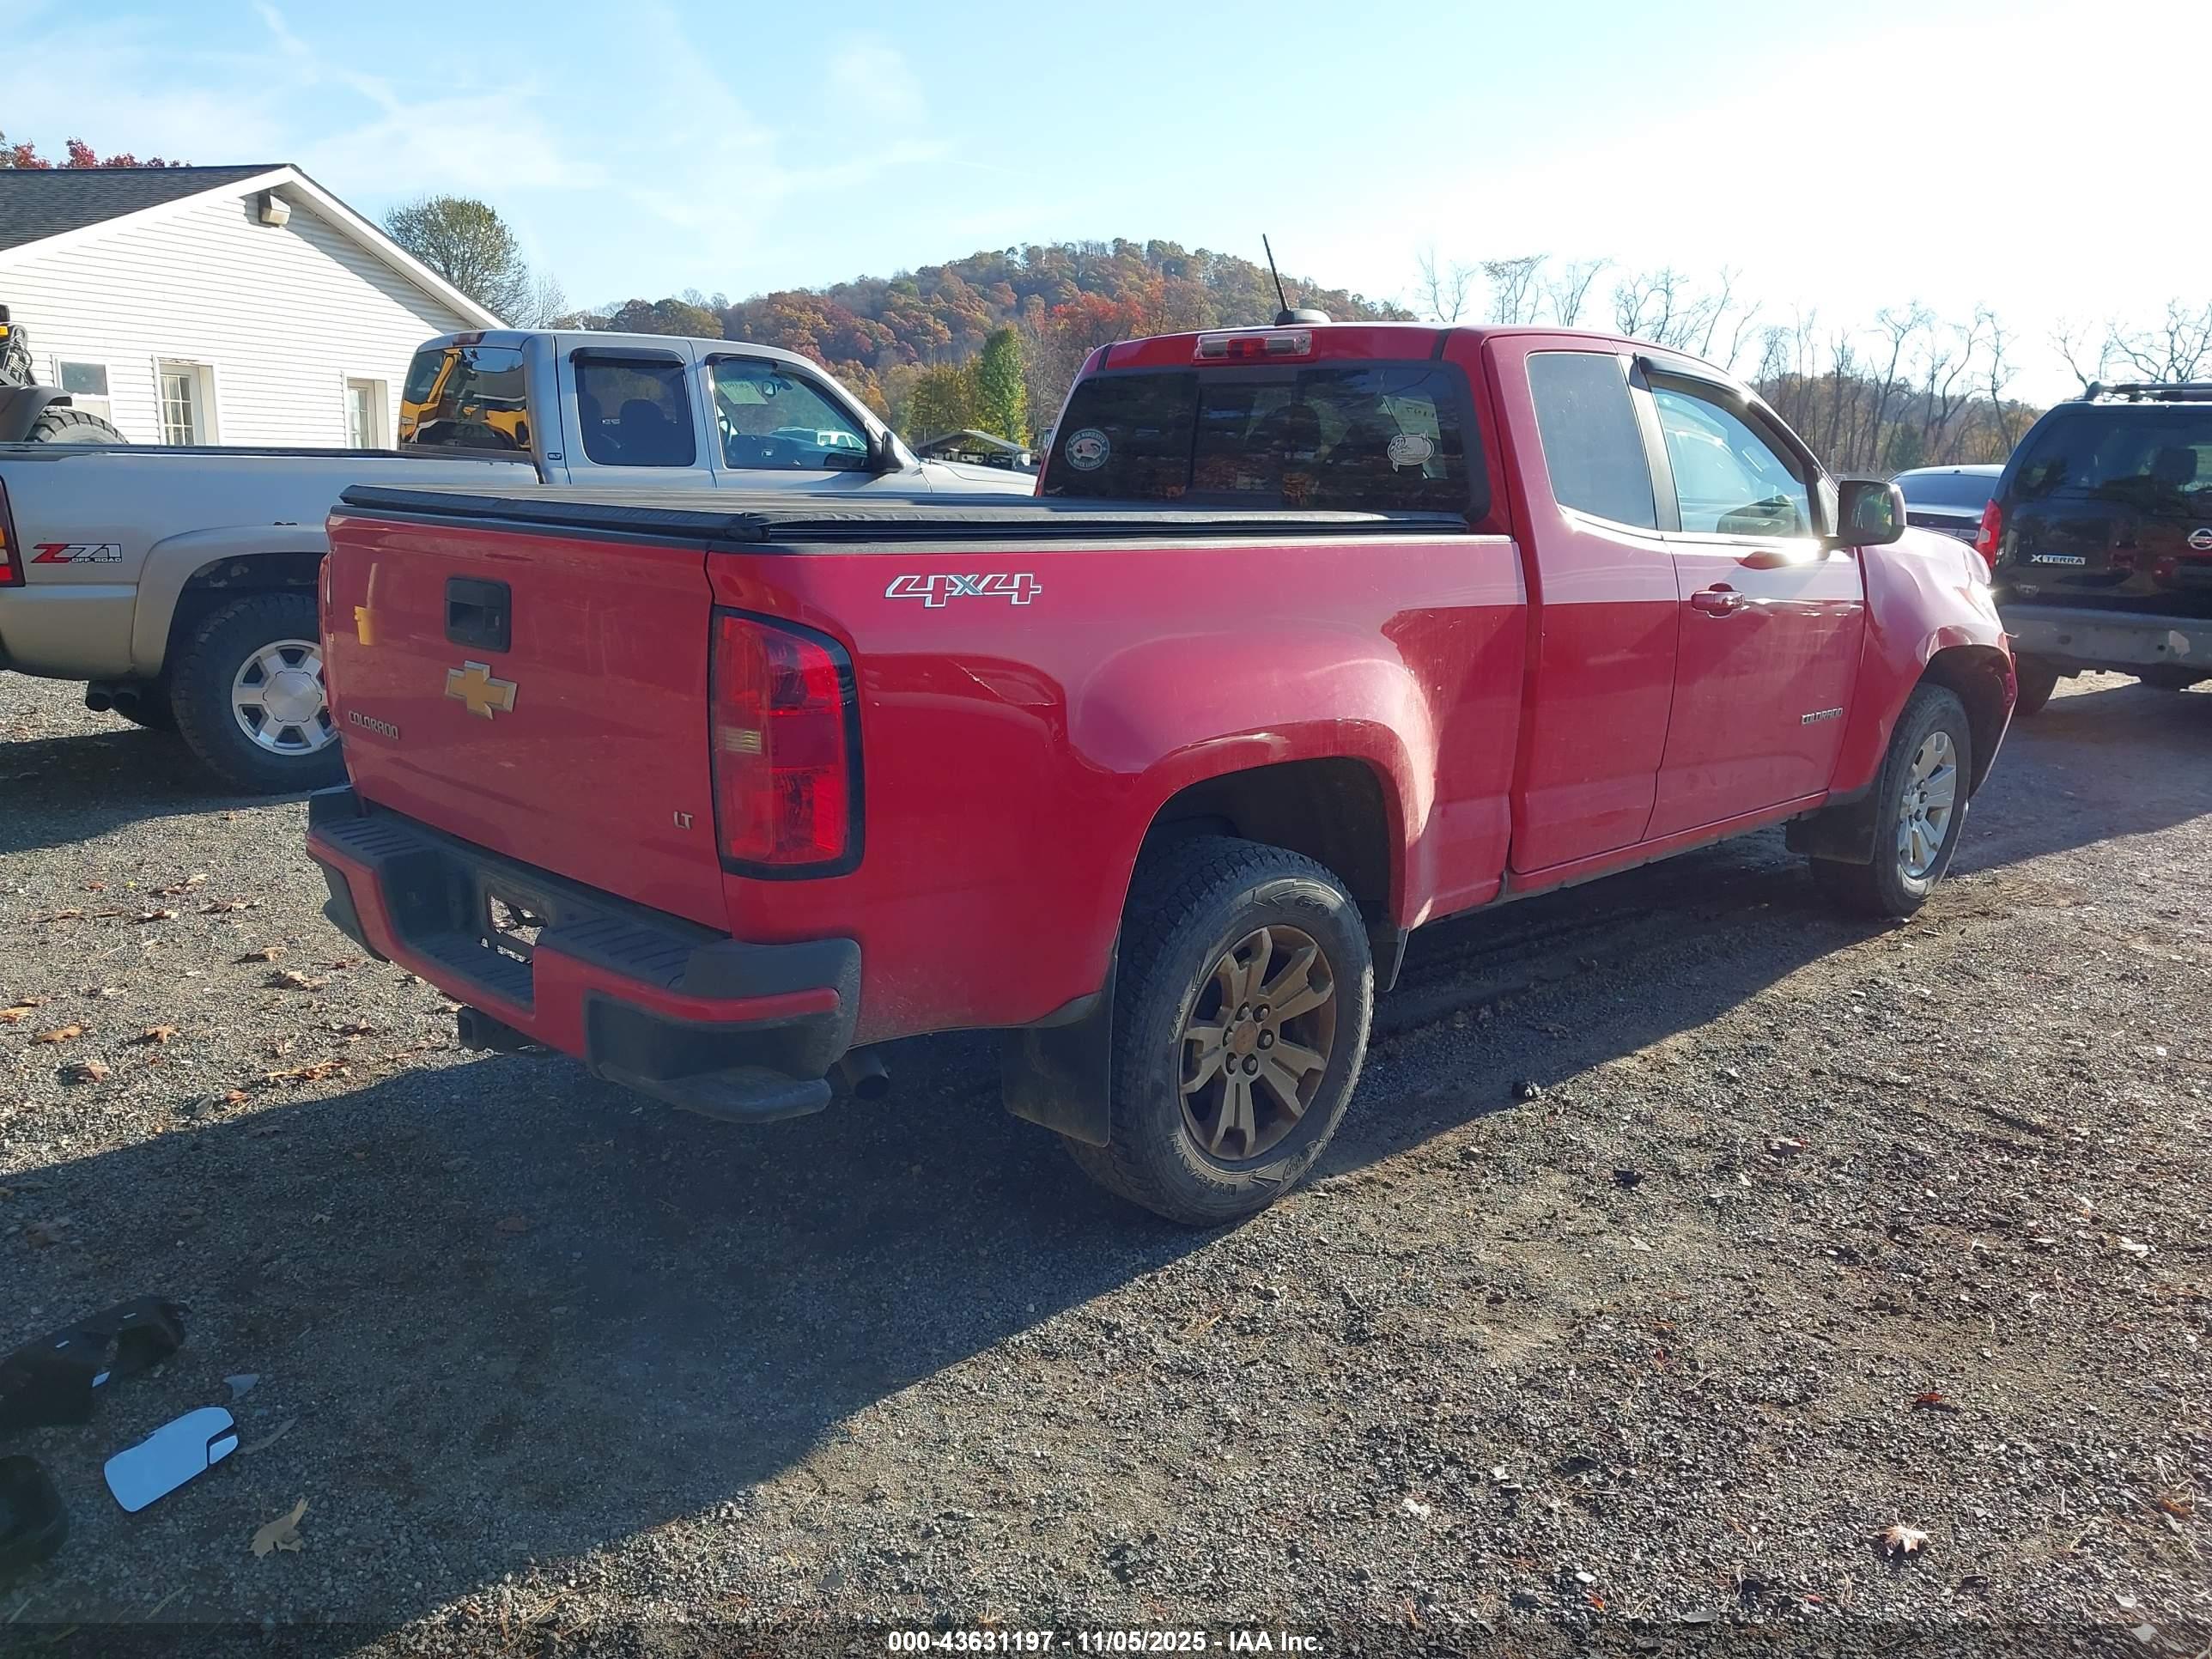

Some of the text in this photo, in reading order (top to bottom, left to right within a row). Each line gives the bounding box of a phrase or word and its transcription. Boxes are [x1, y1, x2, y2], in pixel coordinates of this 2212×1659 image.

[31, 543, 121, 562] Z71
[2031, 555, 2085, 565] XTERRA
[349, 710, 398, 739] COLORADO
[1802, 708, 1844, 725] COLORADO
[673, 811, 693, 830] LT
